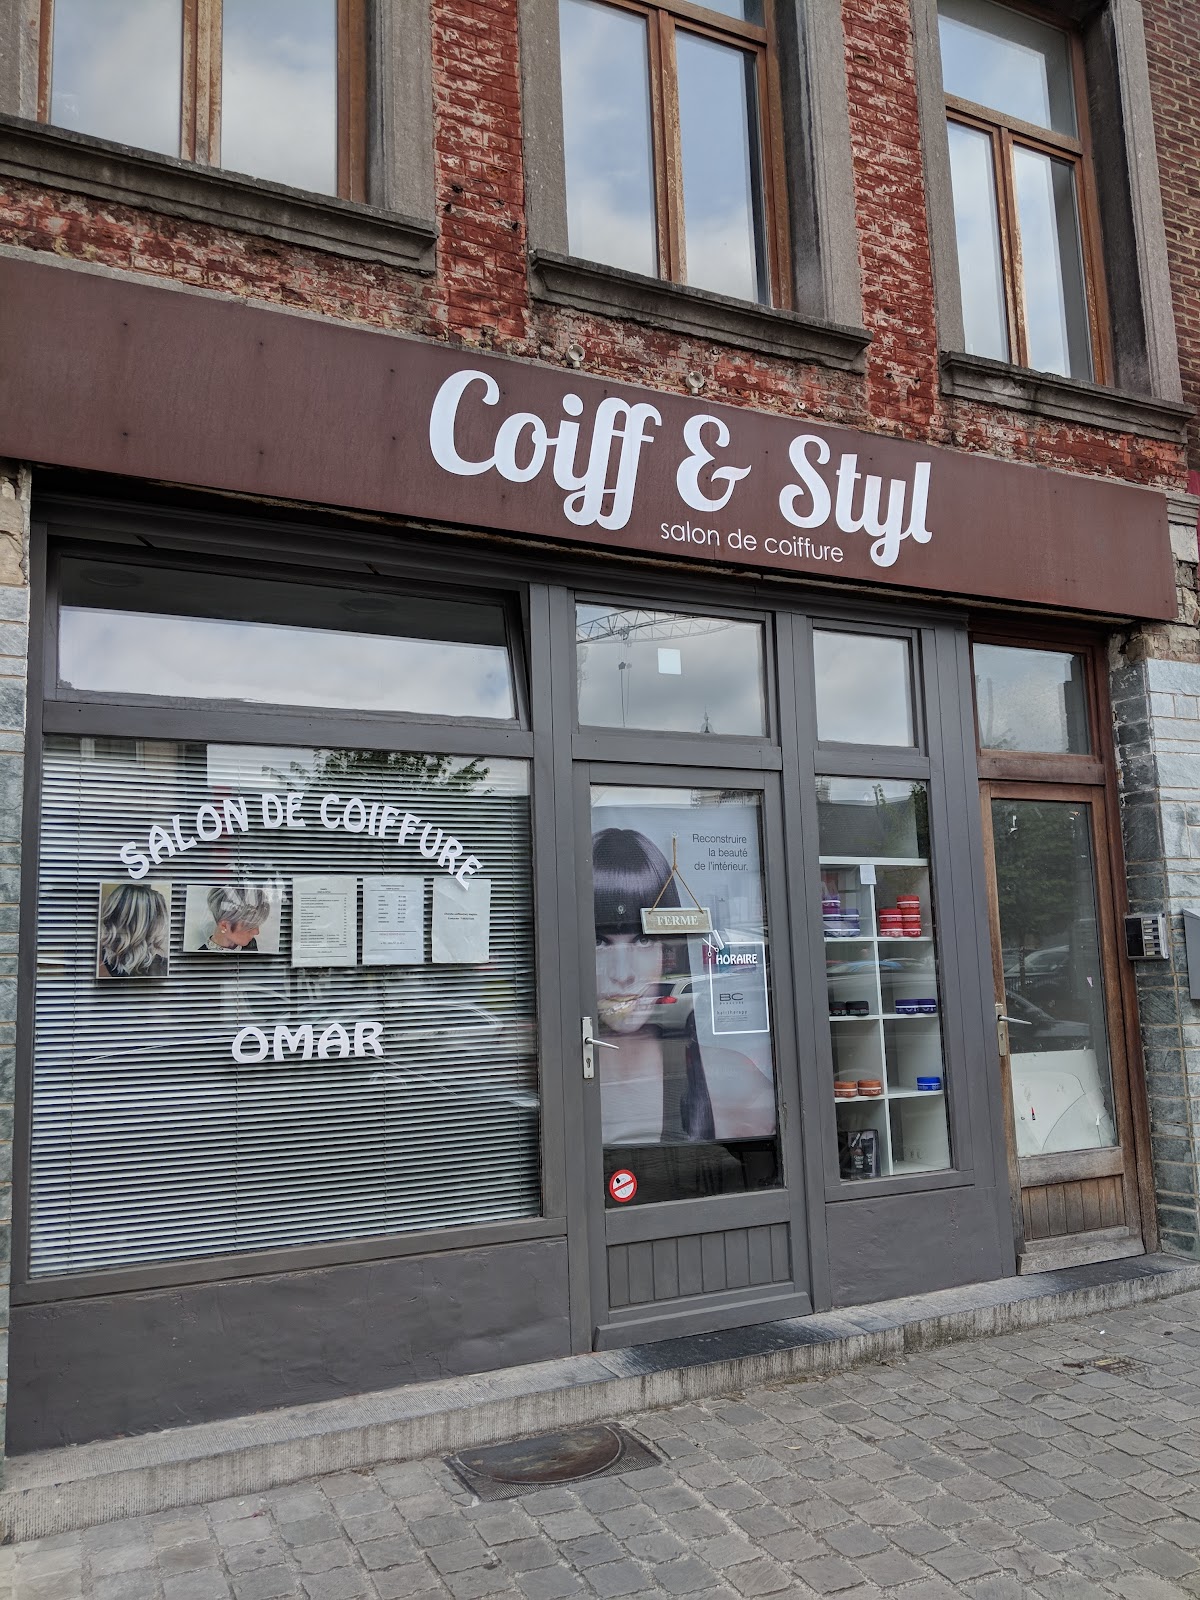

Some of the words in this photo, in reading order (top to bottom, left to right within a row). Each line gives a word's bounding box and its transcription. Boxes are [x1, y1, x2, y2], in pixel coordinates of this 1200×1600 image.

[429, 369, 662, 530] Coiff
[676, 414, 752, 512] &
[779, 434, 933, 567] Styl
[660, 521, 720, 545] salon
[727, 528, 758, 551] de
[764, 534, 844, 562] coiffure
[119, 796, 249, 880] SALON
[261, 792, 306, 828] DE
[320, 794, 483, 891] COIFFURE
[692, 833, 747, 844] Reconstruire
[708, 847, 716, 857] la
[718, 847, 748, 858] beauté
[694, 861, 706, 871] de
[708, 861, 749, 871] l'intérieur.
[715, 953, 759, 965] HORAIRE
[719, 993, 744, 1002] BC
[231, 1022, 385, 1064] OMAR
